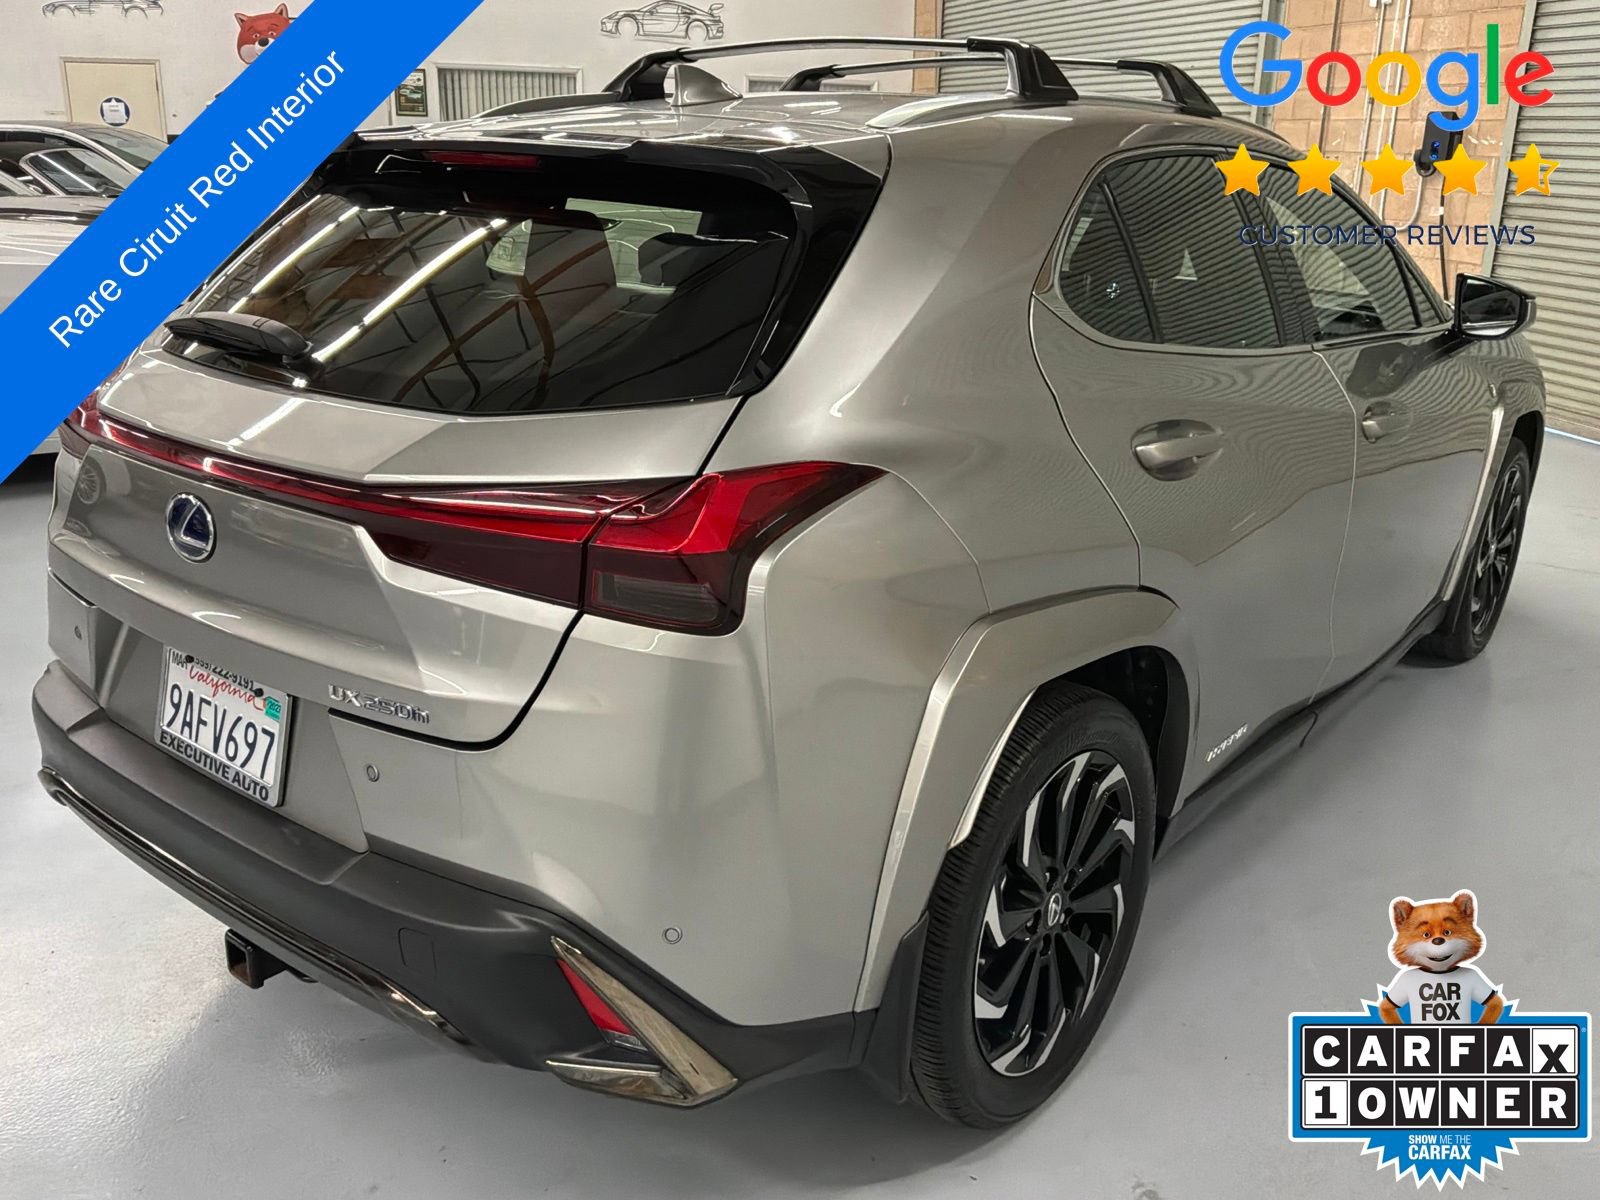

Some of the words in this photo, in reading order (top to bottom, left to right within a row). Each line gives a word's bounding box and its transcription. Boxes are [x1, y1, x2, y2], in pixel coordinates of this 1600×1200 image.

[327, 683, 362, 708] UX
[159, 730, 231, 781] EXECUTIVE
[231, 769, 269, 801] AUTO
[166, 683, 275, 780] 9AFV697
